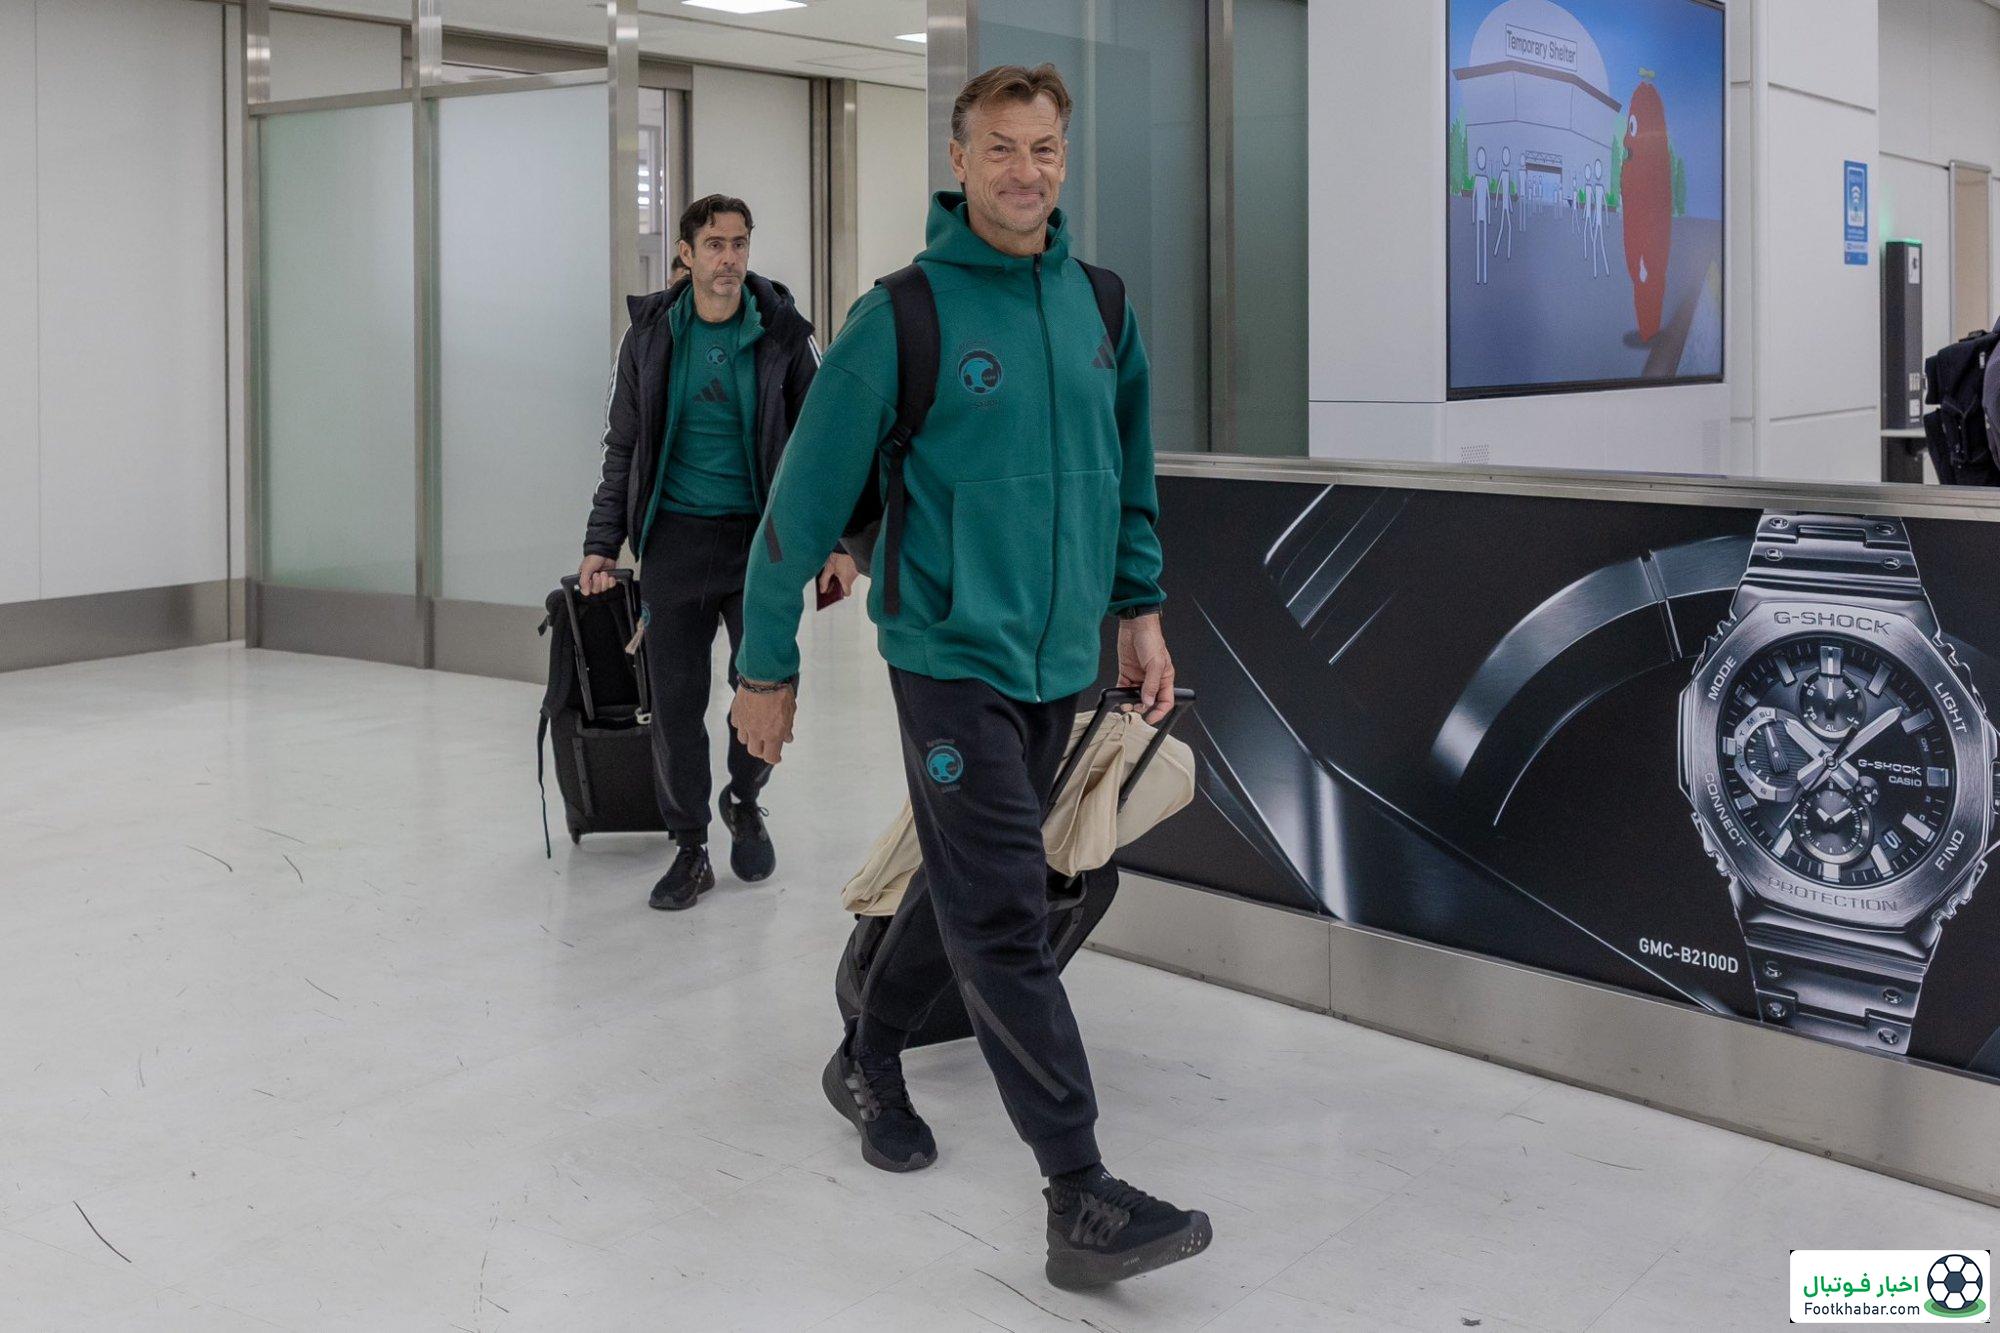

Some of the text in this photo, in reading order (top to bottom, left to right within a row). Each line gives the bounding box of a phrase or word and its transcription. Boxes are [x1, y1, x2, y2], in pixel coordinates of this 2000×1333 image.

[1506, 30, 1576, 63] Temporary Shelter
[1773, 611, 1891, 636] G-SHOCK
[1708, 656, 1737, 701] MODE
[1934, 682, 1968, 733] LIGHT
[1858, 759, 1922, 776] G-SHOCK
[1888, 776, 1923, 787] CASIO
[1704, 772, 1747, 847] CONNECT
[1934, 829, 1966, 871] FIND
[1767, 876, 1898, 912] PROTECTION
[1639, 937, 1739, 974] GMC-B2100D
